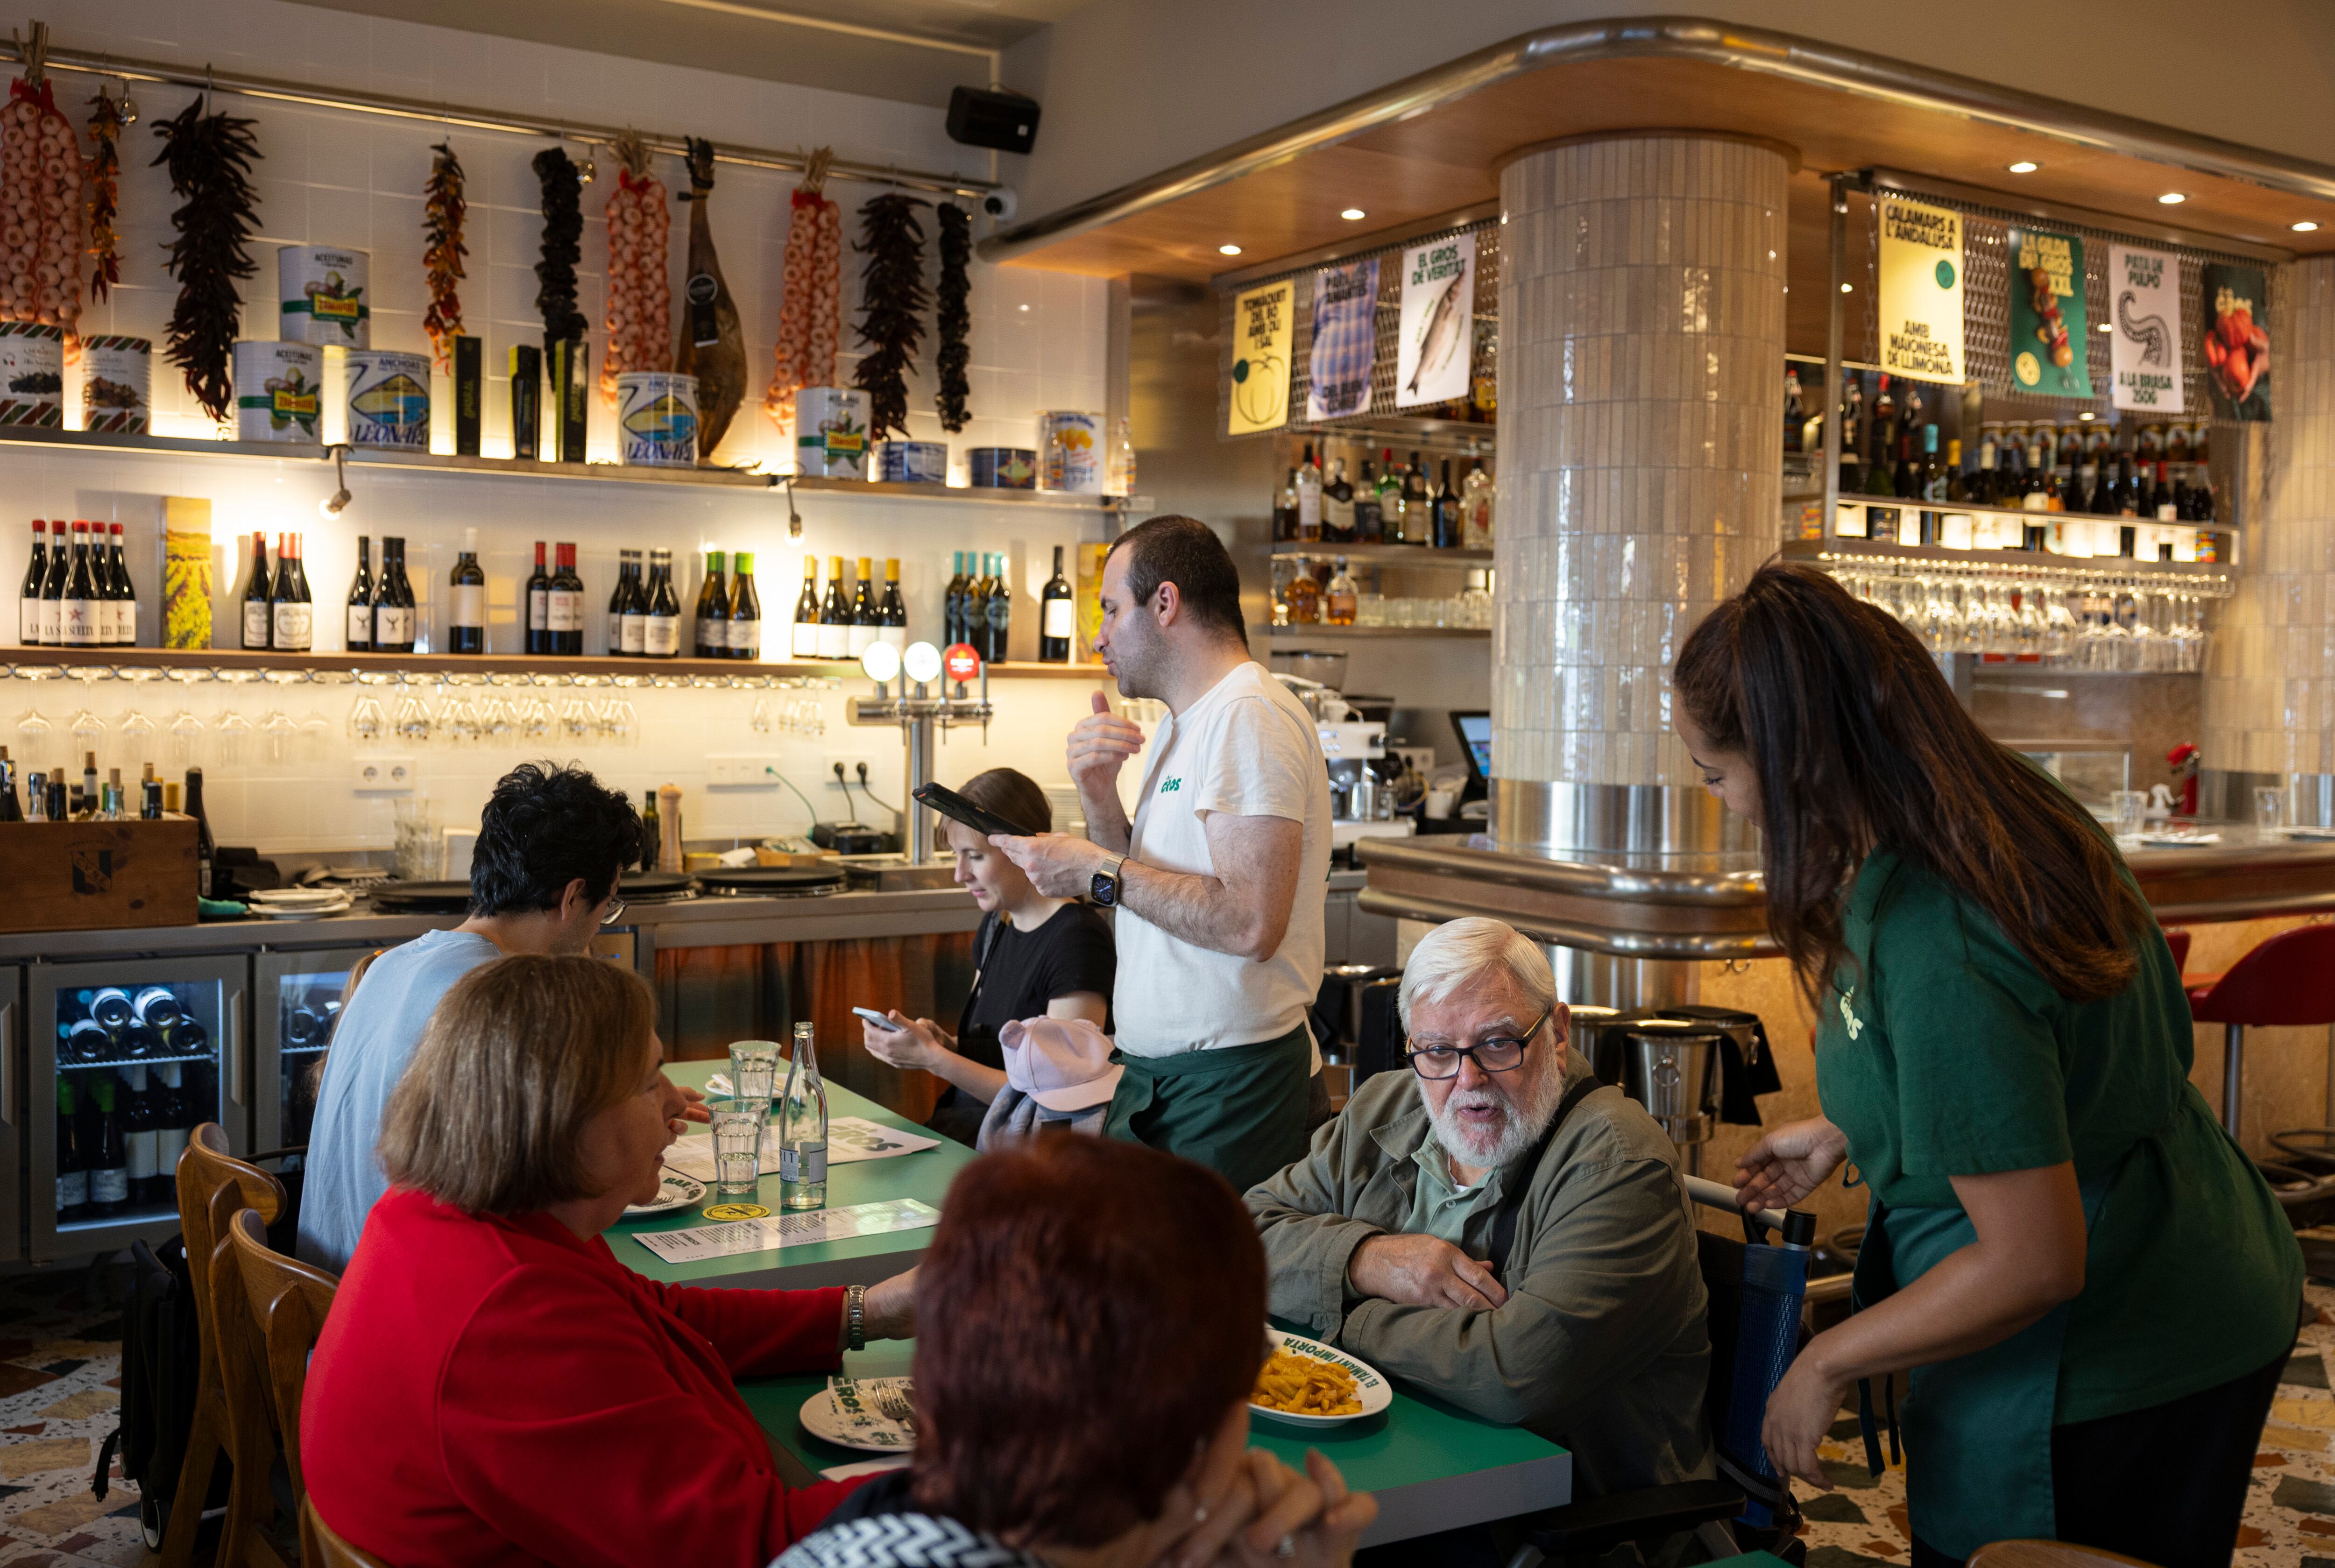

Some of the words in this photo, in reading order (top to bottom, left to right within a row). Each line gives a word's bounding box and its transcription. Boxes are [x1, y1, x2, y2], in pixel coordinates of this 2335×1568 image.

[1887, 205, 1945, 231] CALAMARS
[1948, 219, 1954, 233] A
[1886, 222, 1954, 250] L'ANDALUSA
[2022, 233, 2036, 250] LA
[2038, 235, 2071, 256] GILDA
[1419, 254, 1427, 267] EL
[1430, 244, 1458, 264] GROS
[2019, 250, 2038, 270] DEL
[2041, 255, 2073, 275] GROS
[1412, 269, 1423, 285] DE
[1427, 258, 1465, 281] VERITAT
[2129, 270, 2160, 288] PULPO
[1904, 320, 1929, 338] AMB
[1890, 334, 1948, 357] MAIONESA
[1888, 351, 1897, 367] DE
[1902, 353, 1953, 374] LLIMONA
[662, 1177, 693, 1188] BAR
[1282, 1337, 1339, 1362] IMPORTA
[1336, 1358, 1373, 1382] TAMANY
[1364, 1377, 1380, 1389] EL
